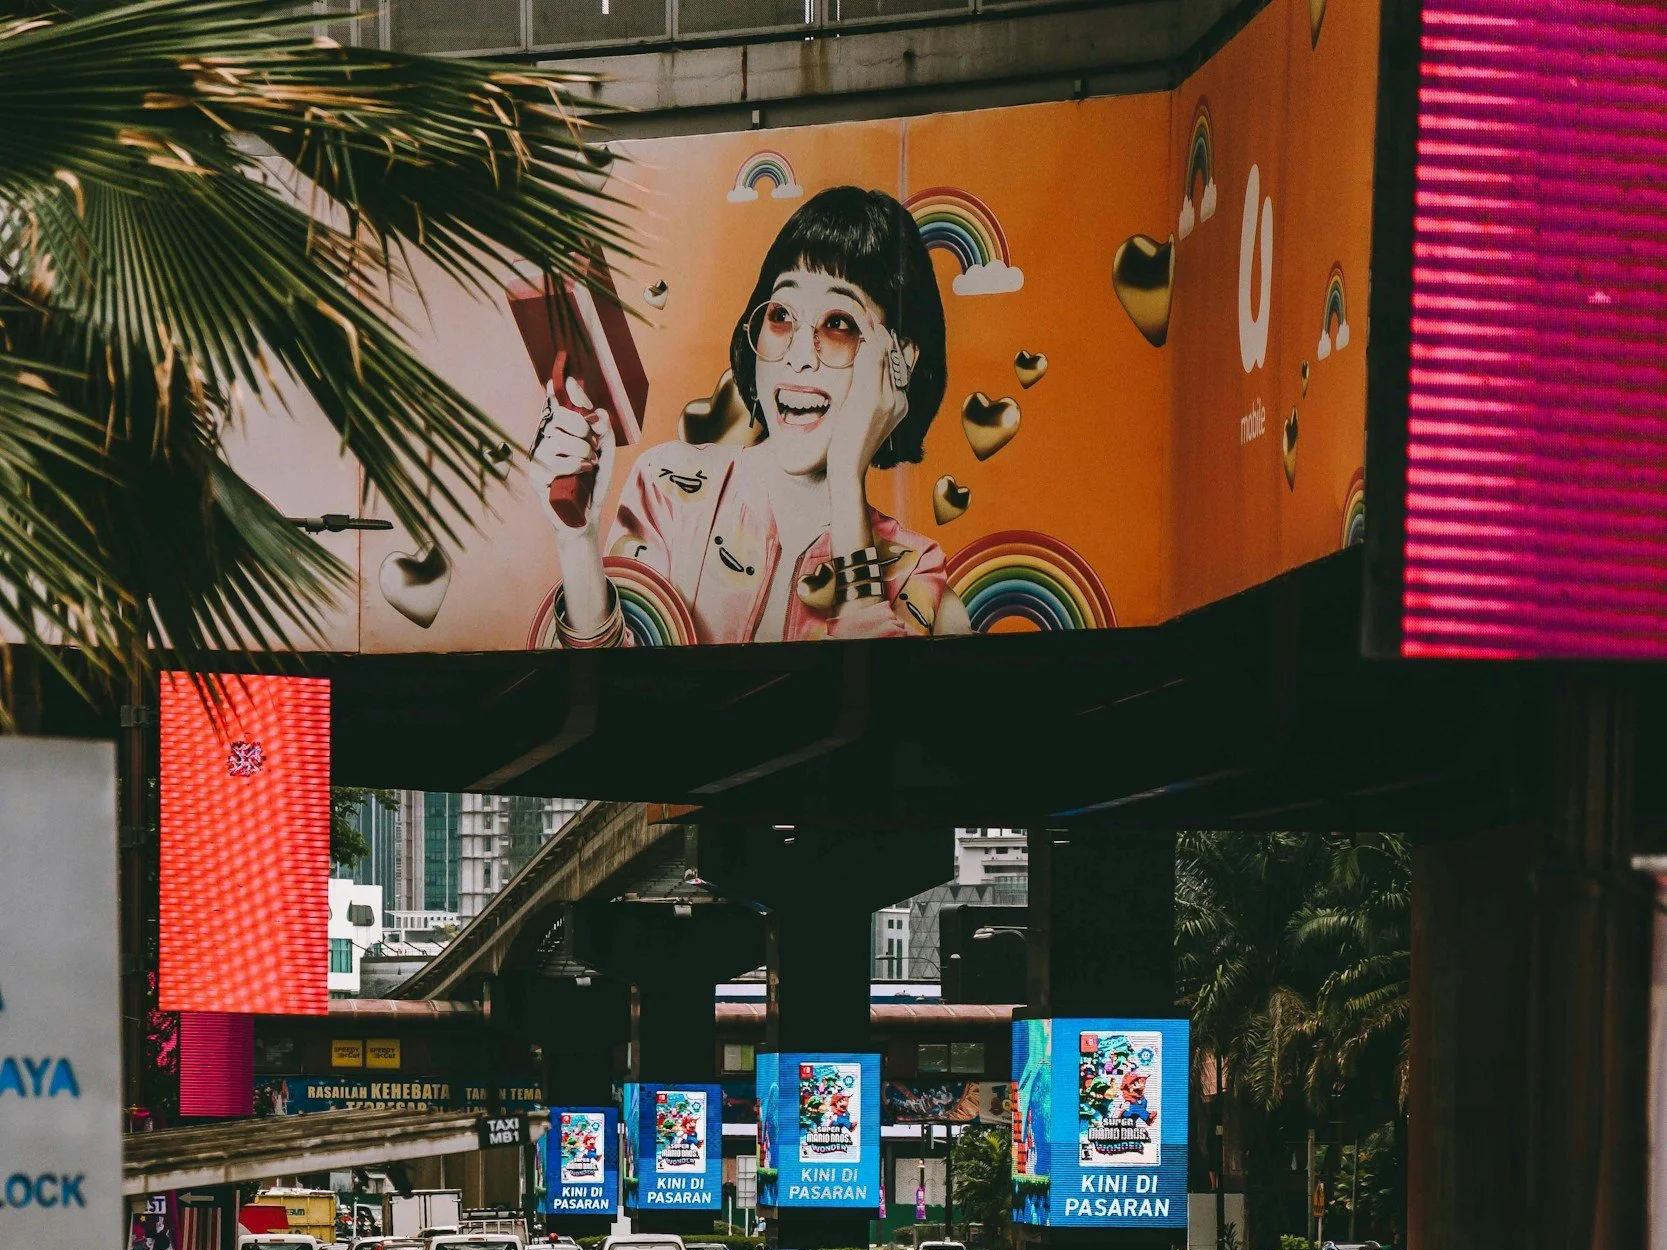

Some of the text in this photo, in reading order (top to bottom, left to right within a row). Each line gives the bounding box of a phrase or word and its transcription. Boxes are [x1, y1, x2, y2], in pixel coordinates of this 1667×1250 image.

[1240, 397, 1266, 446] mobile
[307, 1085, 368, 1099] RASAILAH
[370, 1082, 450, 1100] KEHEBATA
[510, 1088, 543, 1101] TEMA
[487, 1118, 520, 1132] TAXI
[489, 1131, 520, 1145] MB1
[801, 1167, 859, 1183] KINI DI
[656, 1177, 705, 1190] KINI DI
[1081, 1174, 1158, 1194] KINI DI
[0, 1173, 87, 1209] OCK
[561, 1186, 603, 1198] KINI DI
[647, 1191, 712, 1204] PASARAN
[789, 1185, 867, 1200] PASARAN
[146, 1198, 165, 1212] ST
[553, 1198, 609, 1210] PASARAN
[1065, 1198, 1170, 1217] PASARAN
